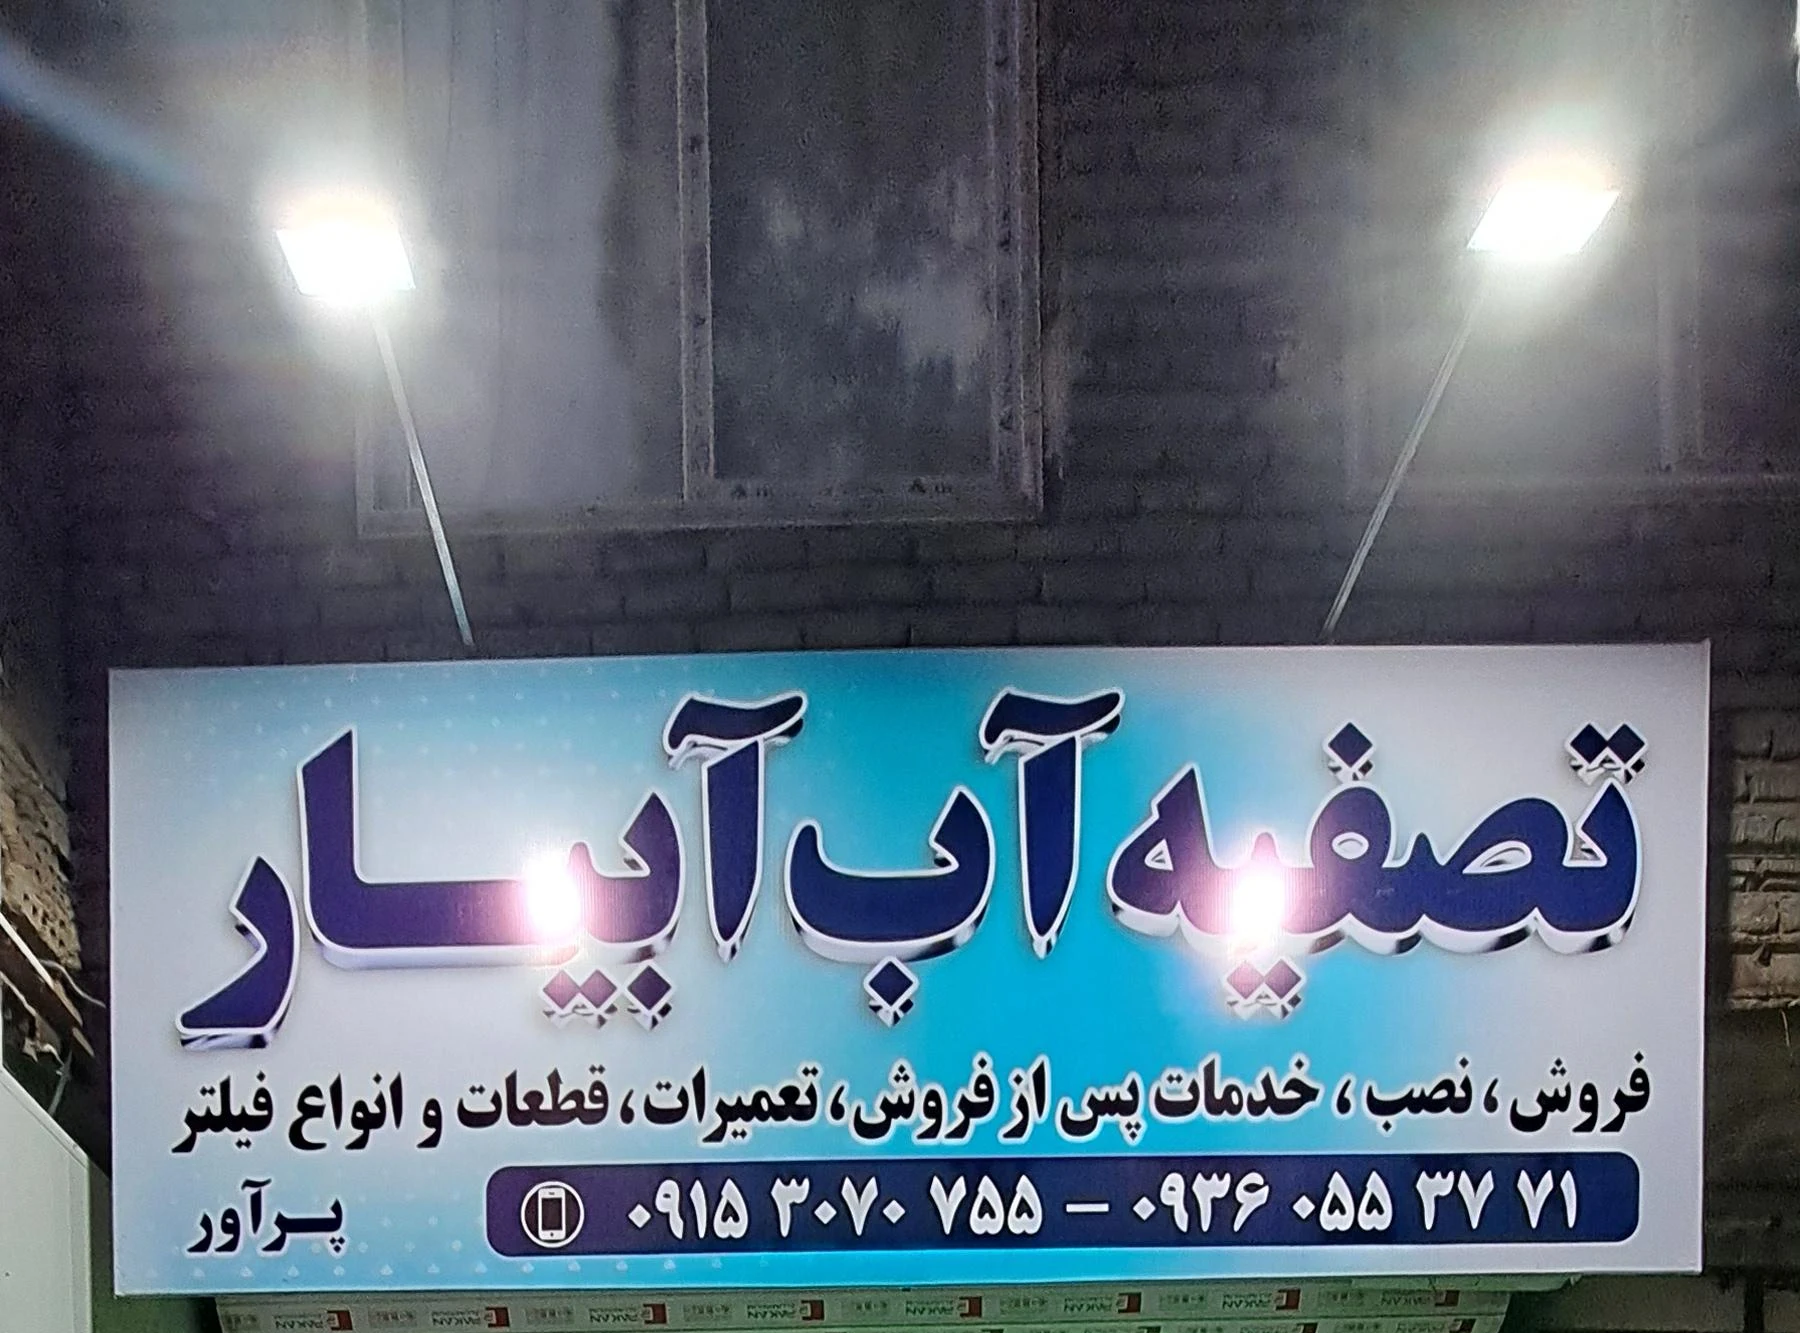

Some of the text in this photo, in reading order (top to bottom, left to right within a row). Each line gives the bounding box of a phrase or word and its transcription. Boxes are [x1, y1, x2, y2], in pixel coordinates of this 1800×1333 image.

[174, 686, 1648, 1048] تصفیه آب آبیار
[171, 1071, 275, 1152] فیلتر
[288, 1072, 403, 1151] انواع
[418, 1093, 442, 1148] و
[457, 1065, 609, 1129] قطعات
[1001, 1056, 1047, 1141] از
[1060, 1072, 1140, 1143] پس
[1152, 1055, 1320, 1119] خدمات
[627, 1179, 748, 1240] ۰۹۱۵
[770, 1177, 906, 1239] ۳۰۷۰
[930, 1174, 1044, 1236] ۷۵۵
[1132, 1171, 1271, 1234] ۰۹۳۶
[1292, 1171, 1394, 1233] ۰۵۵
[1416, 1170, 1495, 1232] ۳۷
[1517, 1169, 1580, 1230] ۷۱
